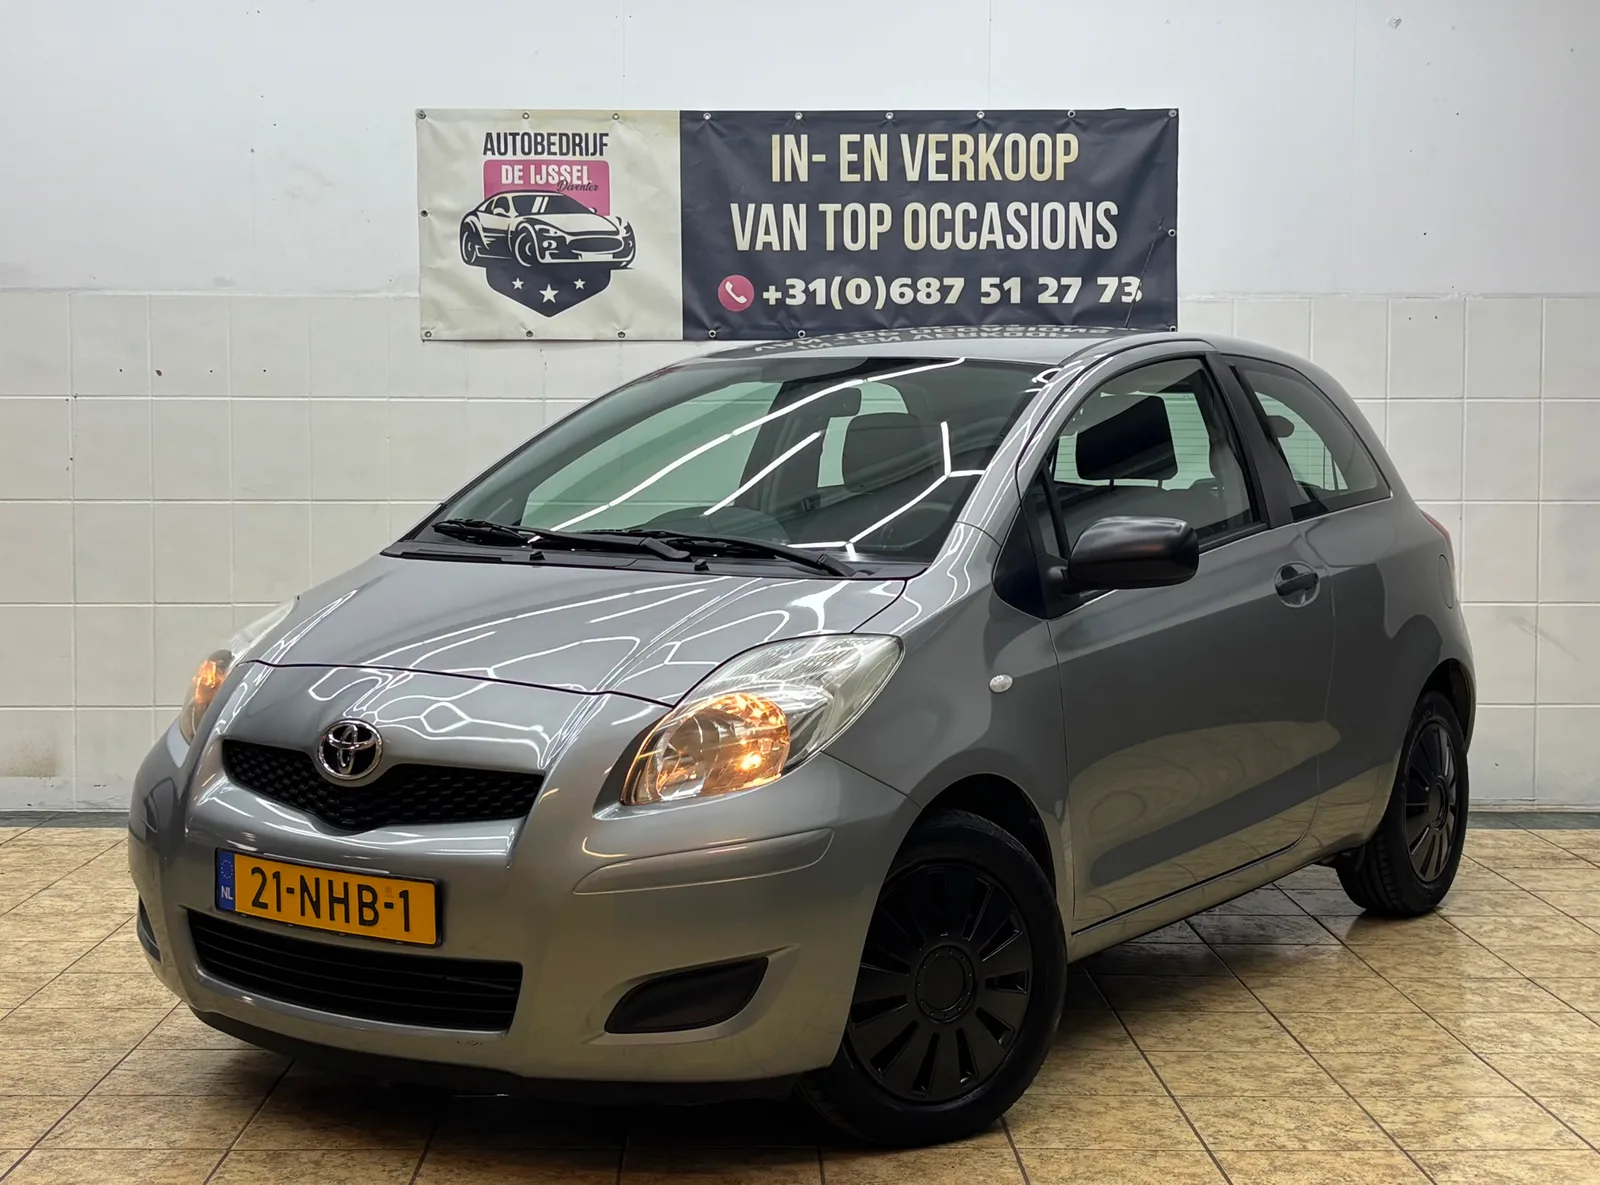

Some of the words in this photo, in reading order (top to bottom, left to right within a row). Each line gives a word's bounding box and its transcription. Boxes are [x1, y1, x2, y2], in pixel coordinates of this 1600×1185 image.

[483, 132, 609, 156] AUTOBEDRIJF
[771, 133, 827, 183] IN-
[839, 133, 889, 182] EN
[900, 132, 1080, 182] VERKOOP
[501, 164, 524, 185] DE
[530, 164, 593, 186] IJSSEL
[556, 179, 599, 193] Deventer
[730, 202, 807, 251] VAN
[818, 202, 893, 251] TOP
[903, 200, 1119, 251] OCCASIONS
[762, 275, 965, 311] +31(0)687
[980, 277, 1021, 304] 51
[1037, 276, 1083, 305] 27
[1096, 276, 1143, 304] 73
[221, 886, 234, 901] NL
[251, 867, 410, 933] 21-NHB-1
